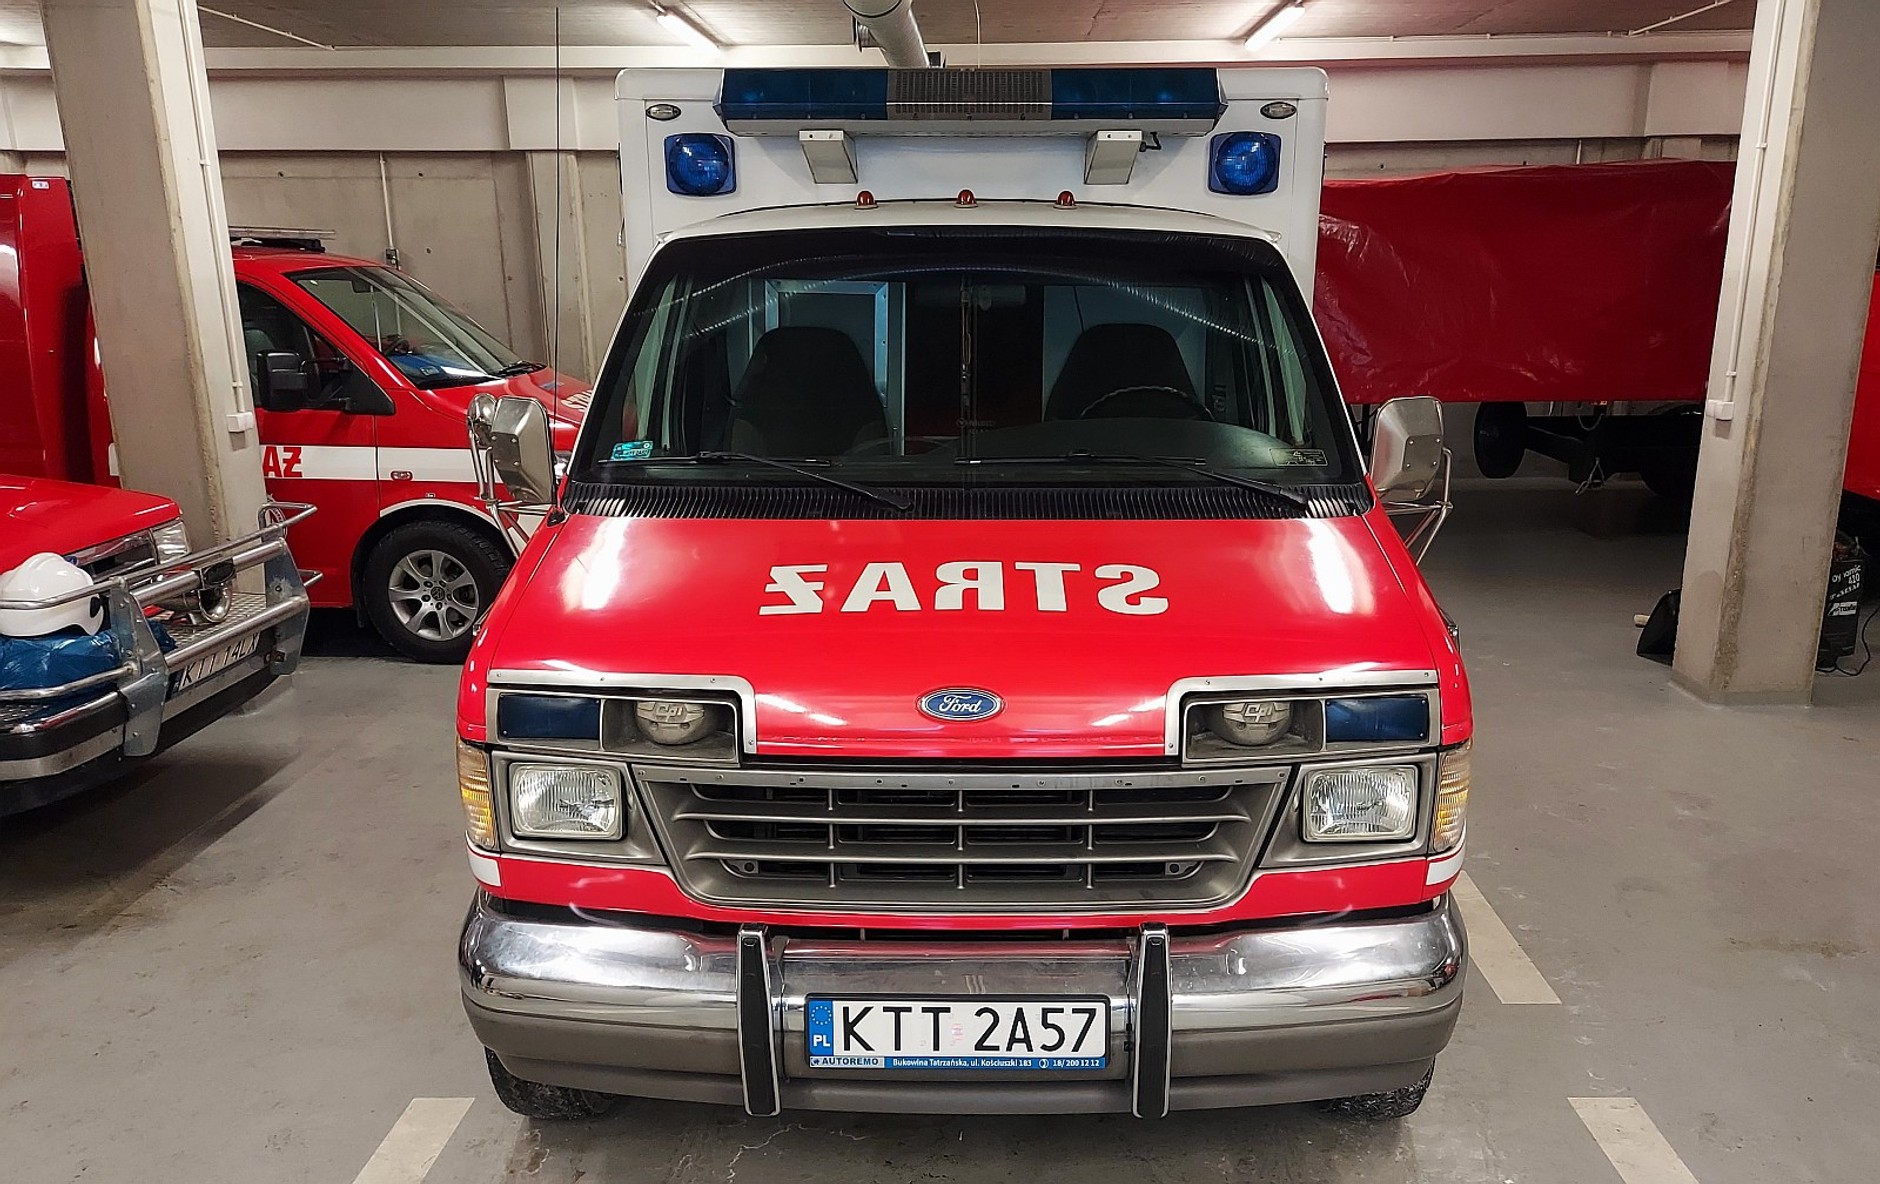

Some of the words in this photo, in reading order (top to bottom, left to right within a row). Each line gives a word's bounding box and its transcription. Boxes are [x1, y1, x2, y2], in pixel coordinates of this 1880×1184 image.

[939, 694, 982, 713] Ford
[842, 1006, 951, 1052] KTT
[973, 1006, 1097, 1053] 2A57
[813, 1034, 831, 1047] PL
[821, 1057, 879, 1066] AUTOREMO
[892, 1058, 928, 1067] Bukowina
[970, 1058, 979, 1067] ul.
[1066, 1058, 1080, 1067] 200
[1081, 1058, 1089, 1067] 12
[1090, 1058, 1100, 1067] 12
